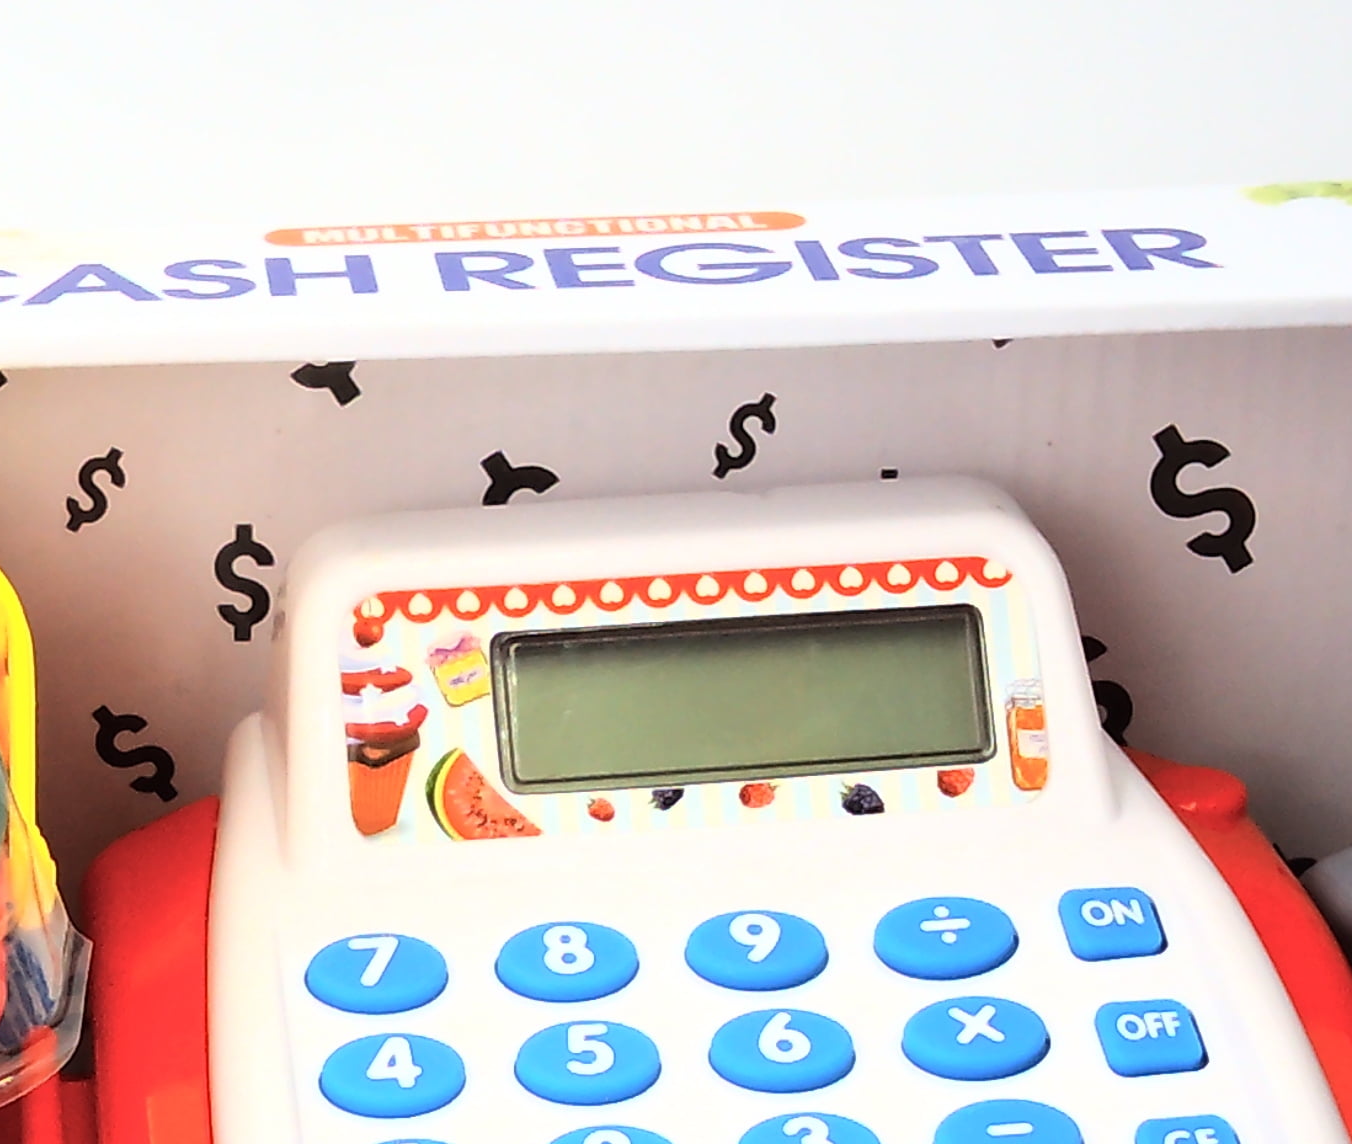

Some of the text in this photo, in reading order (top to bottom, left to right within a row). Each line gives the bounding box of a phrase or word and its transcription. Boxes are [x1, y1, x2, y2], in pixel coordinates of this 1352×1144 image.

[302, 212, 769, 245] MULTIFUNCTIONAL
[433, 226, 1224, 292] REGISTER
[348, 935, 400, 987] 7
[542, 925, 596, 975] 8
[729, 913, 782, 962] 9
[1080, 899, 1146, 928] ON
[366, 1036, 423, 1088] 4
[565, 1022, 616, 1076] 5
[758, 1012, 812, 1064] 6
[1116, 1011, 1180, 1041] OFF
